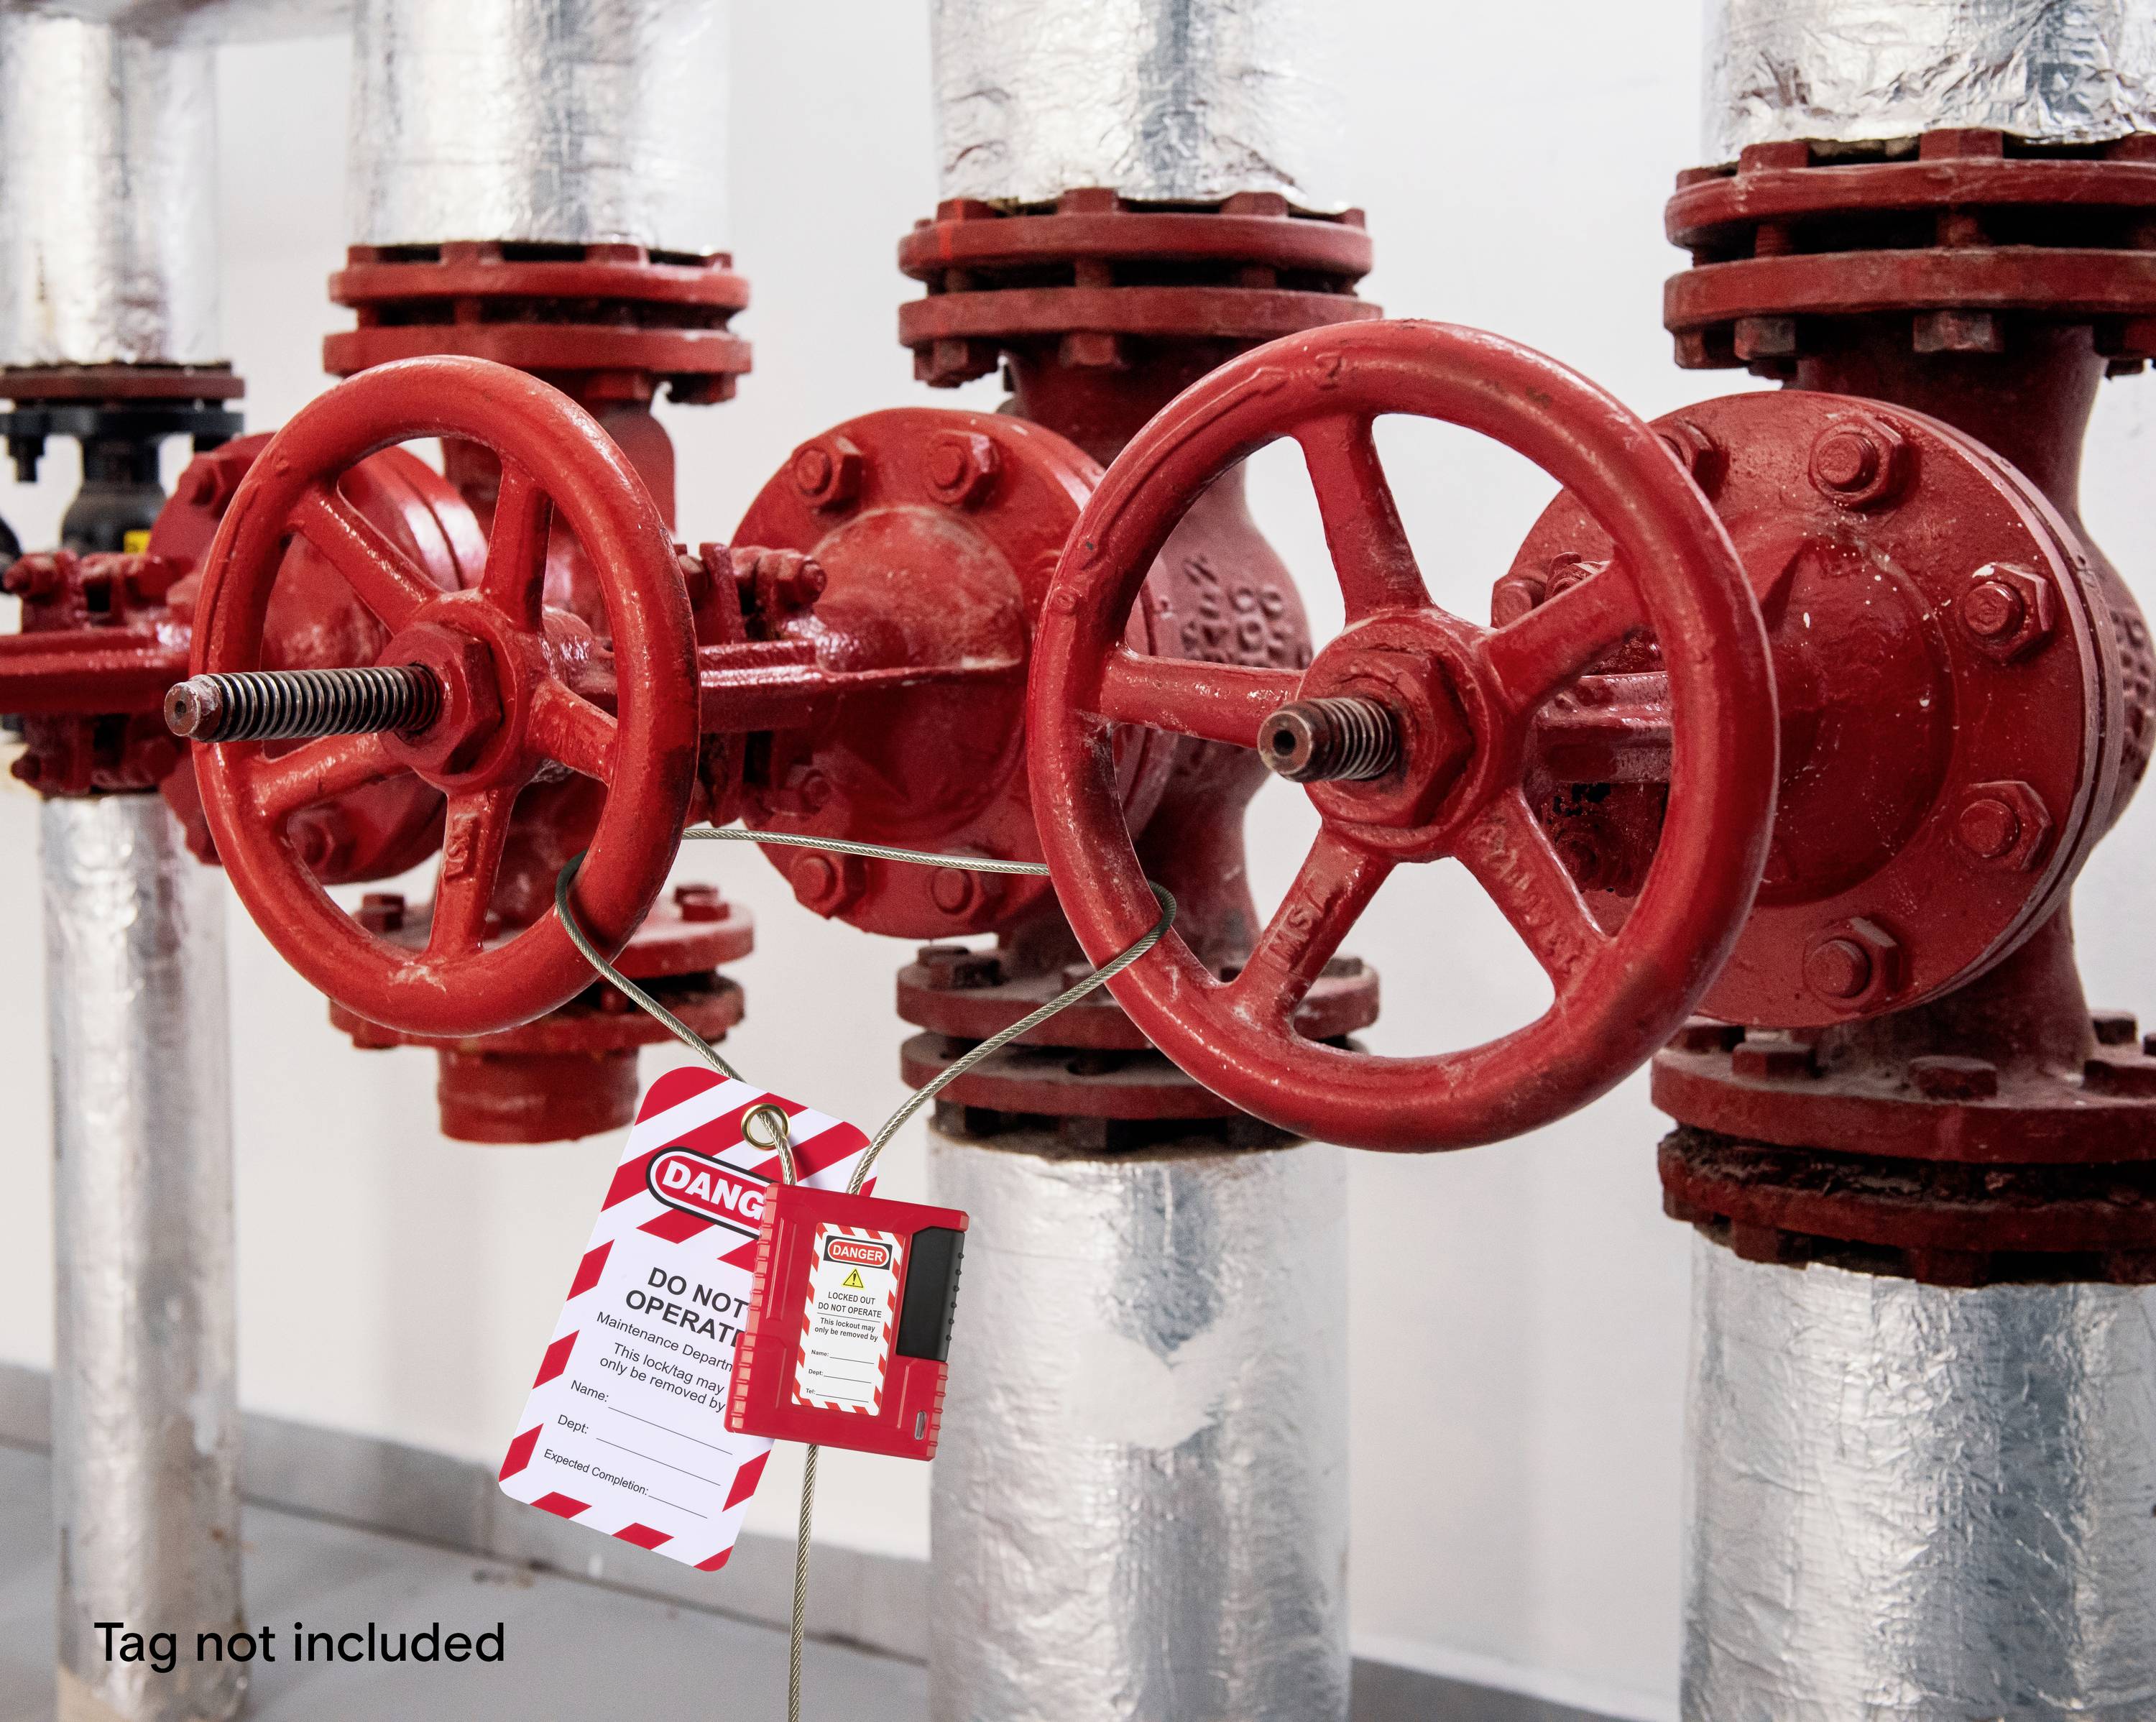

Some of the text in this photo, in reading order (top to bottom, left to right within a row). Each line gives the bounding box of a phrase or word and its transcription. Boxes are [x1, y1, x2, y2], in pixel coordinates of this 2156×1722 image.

[662, 1160, 765, 1220] DANG
[832, 1244, 883, 1262] DANGER
[648, 1267, 750, 1319] DO NOT
[828, 1292, 875, 1305] LOCKED OUT
[818, 1302, 883, 1318] DO NOT OPERATE
[596, 1312, 679, 1351] Maintenance
[814, 1326, 829, 1335] only
[840, 1330, 868, 1340] removed
[870, 1333, 878, 1343] by
[836, 1320, 860, 1330] lockout
[862, 1325, 875, 1333] may
[614, 1343, 725, 1396] This lock/tag may
[571, 1380, 609, 1402] Name:
[599, 1358, 726, 1413] only be removed by
[558, 1414, 589, 1434] Dept:
[544, 1448, 649, 1496] Expected Completion:
